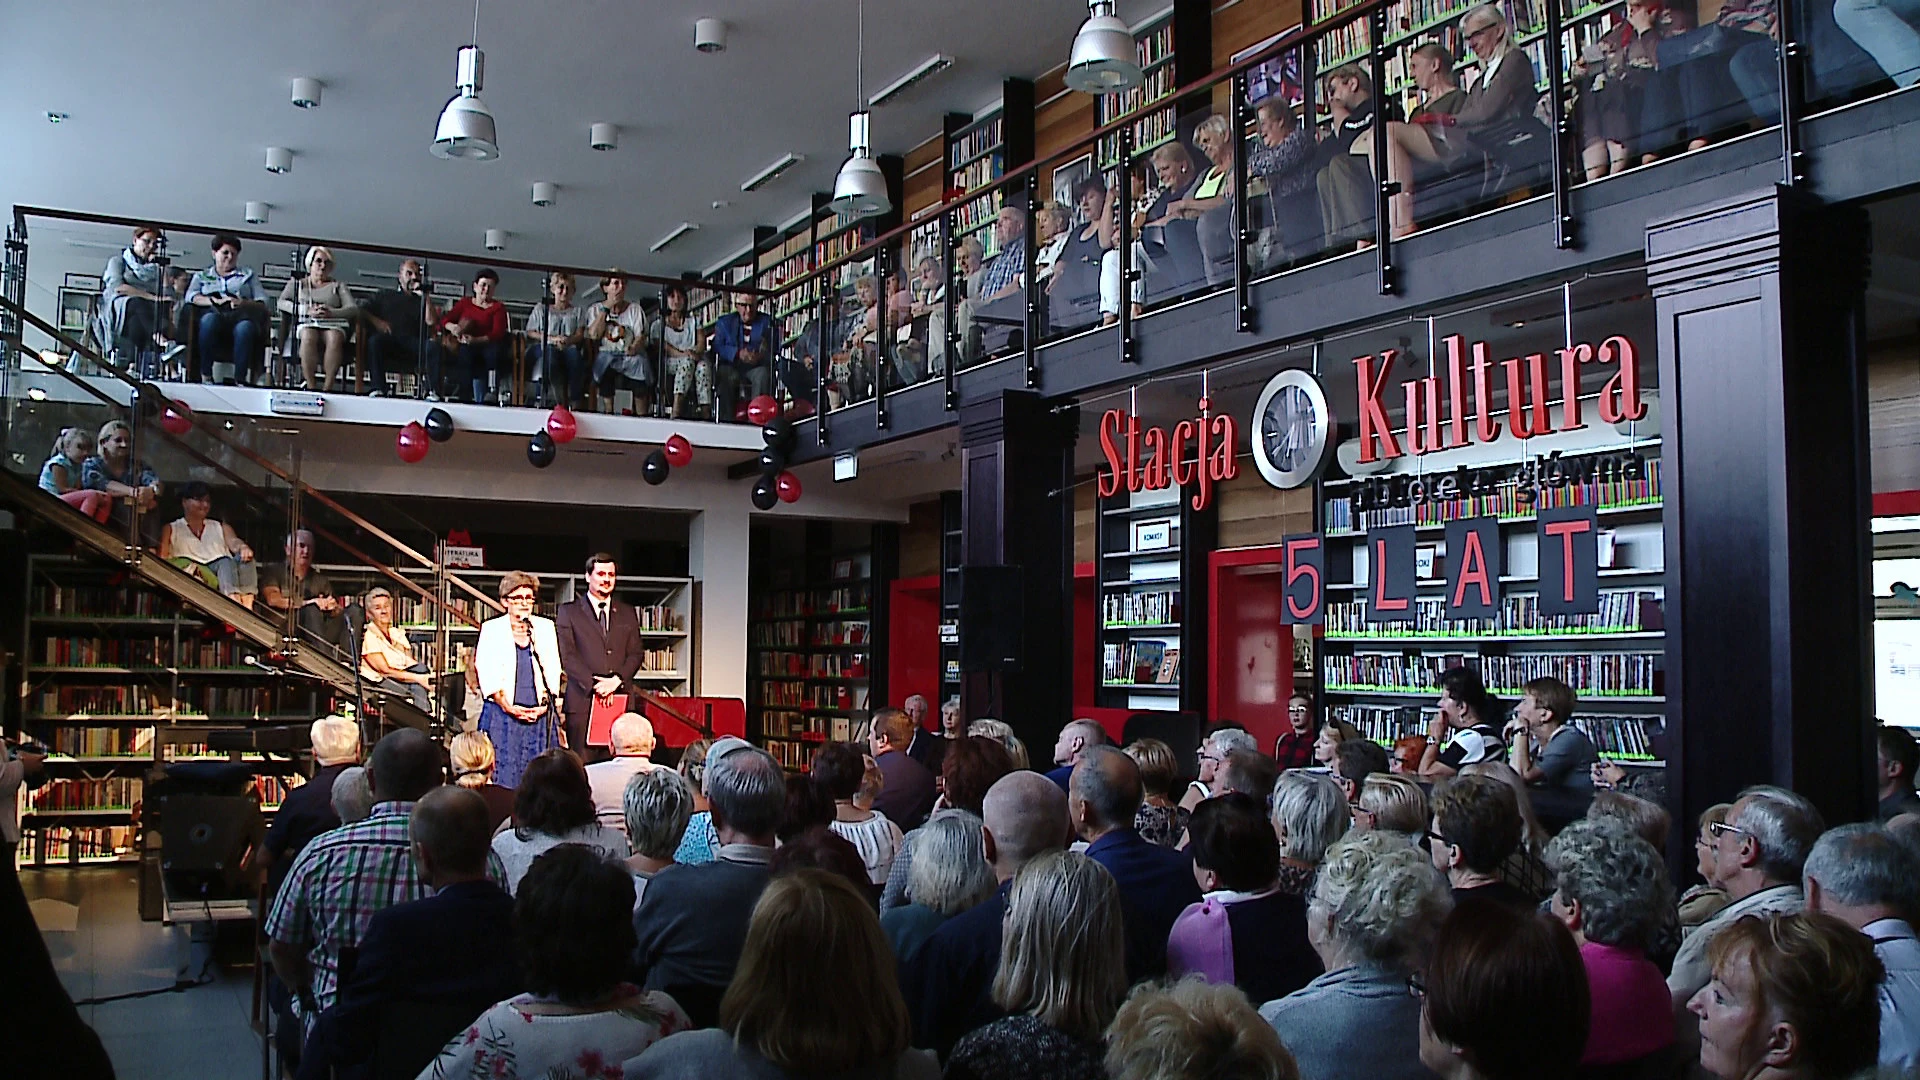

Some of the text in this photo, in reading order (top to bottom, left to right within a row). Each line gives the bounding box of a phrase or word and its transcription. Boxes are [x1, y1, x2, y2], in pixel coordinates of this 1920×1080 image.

[1098, 333, 1648, 511] Stacja Kultura
[1287, 539, 1320, 619] 5
